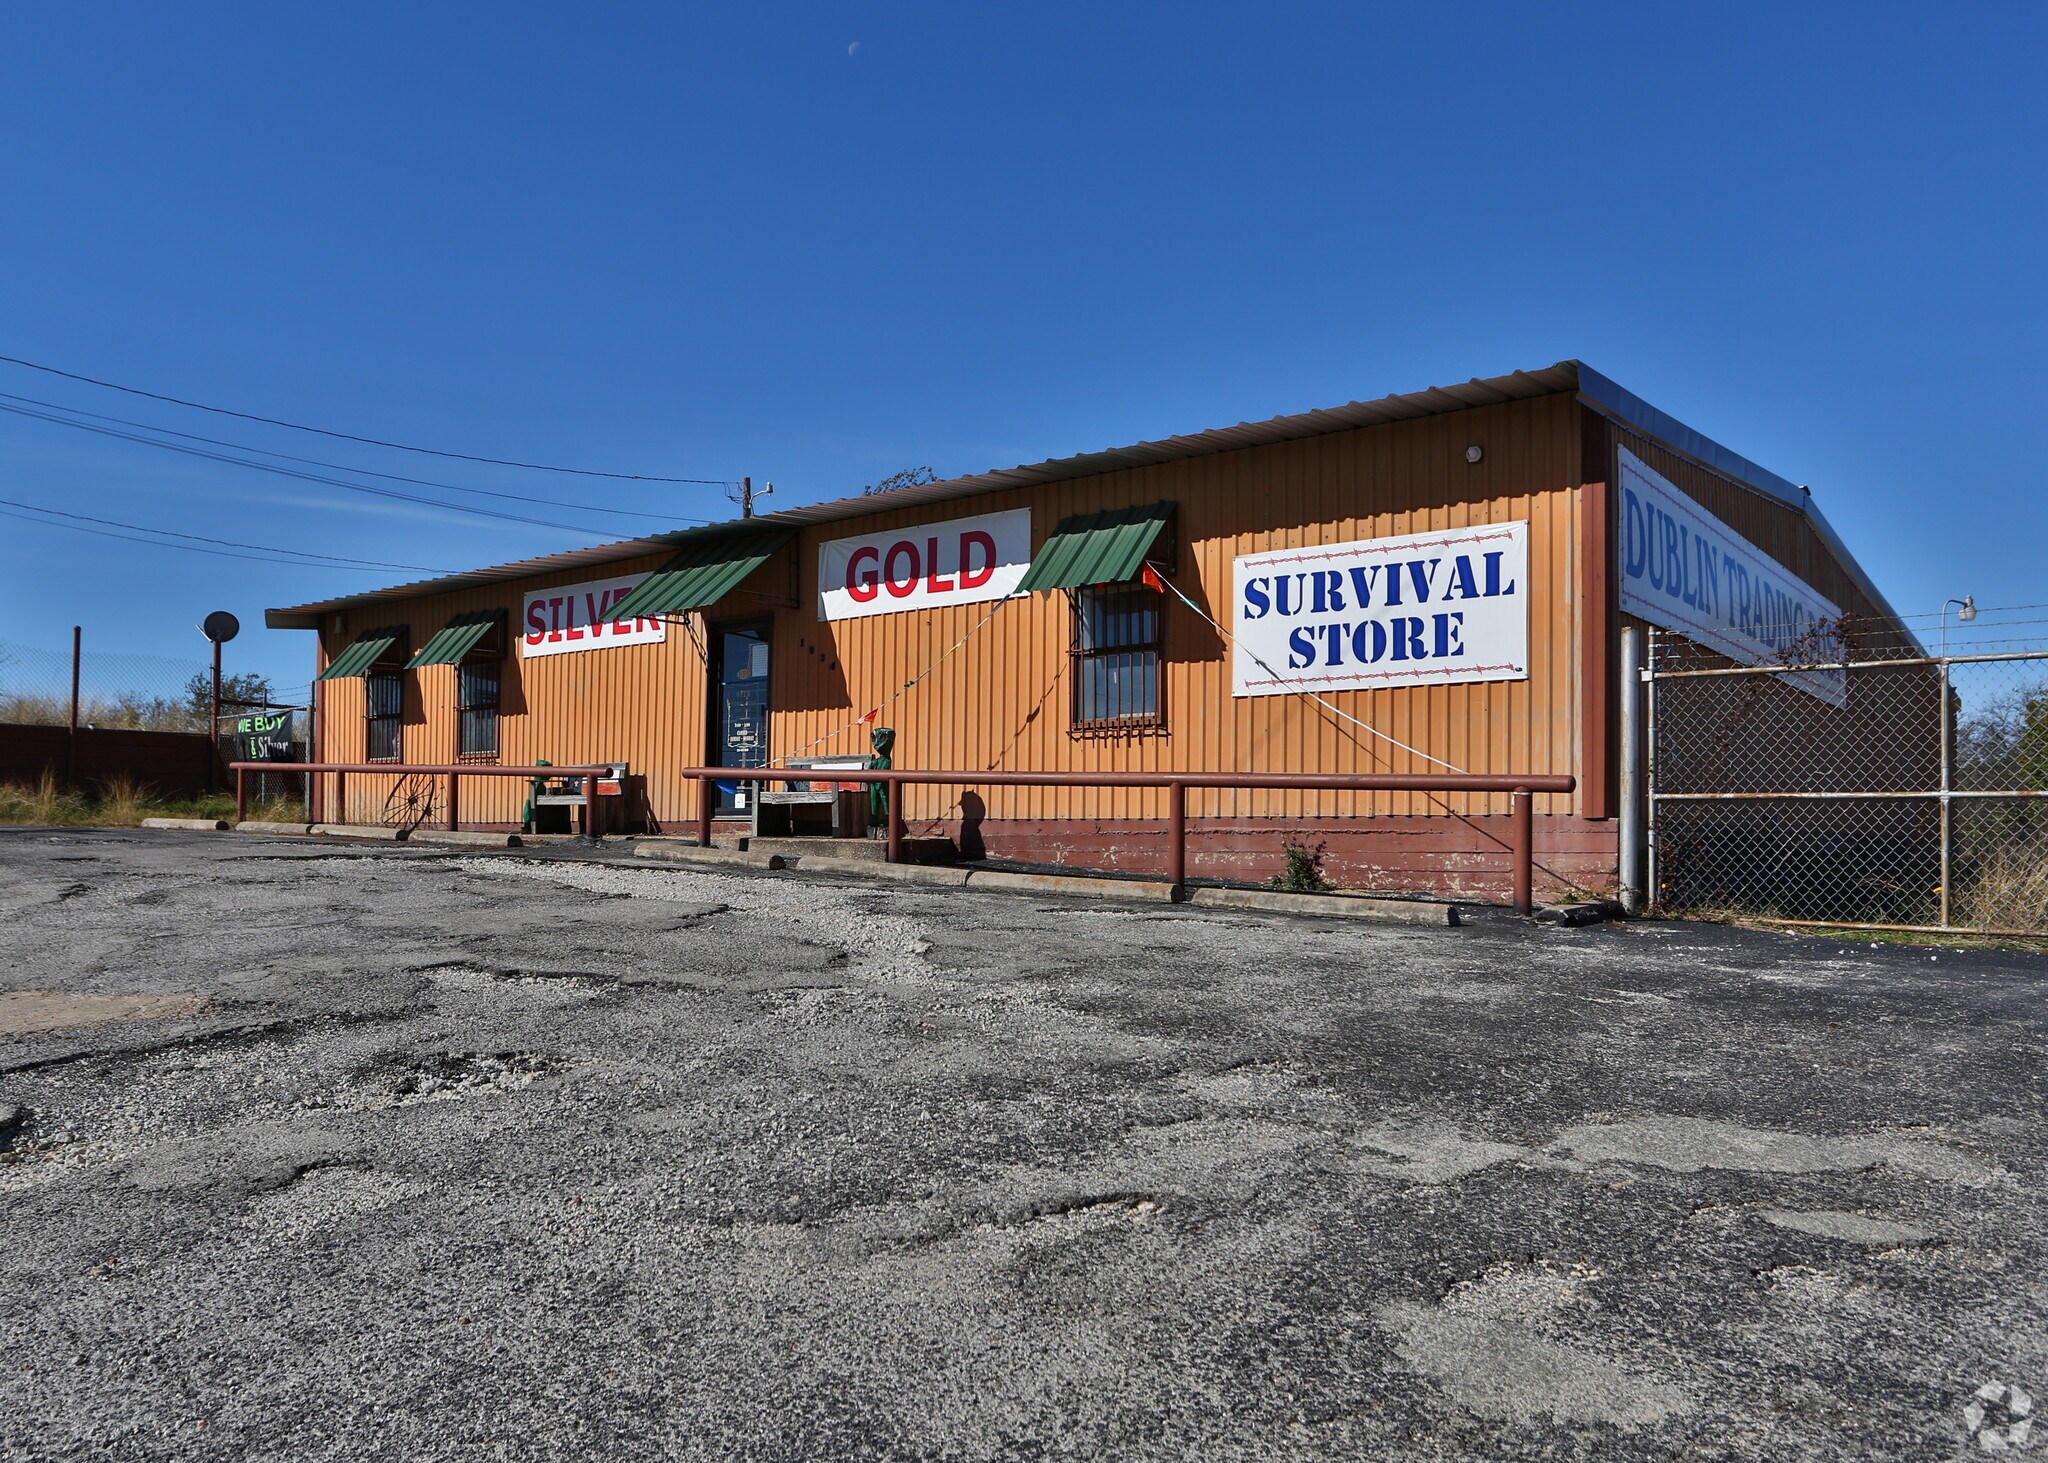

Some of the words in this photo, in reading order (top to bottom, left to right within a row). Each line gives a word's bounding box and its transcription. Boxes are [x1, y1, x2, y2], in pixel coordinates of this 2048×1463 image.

[846, 530, 997, 603] GOLD
[1243, 551, 1515, 620] SURVIVAL
[1625, 487, 1720, 620] DUBLIN
[1288, 611, 1464, 670] STORE
[237, 718, 252, 733] WE
[254, 715, 286, 732] BUY
